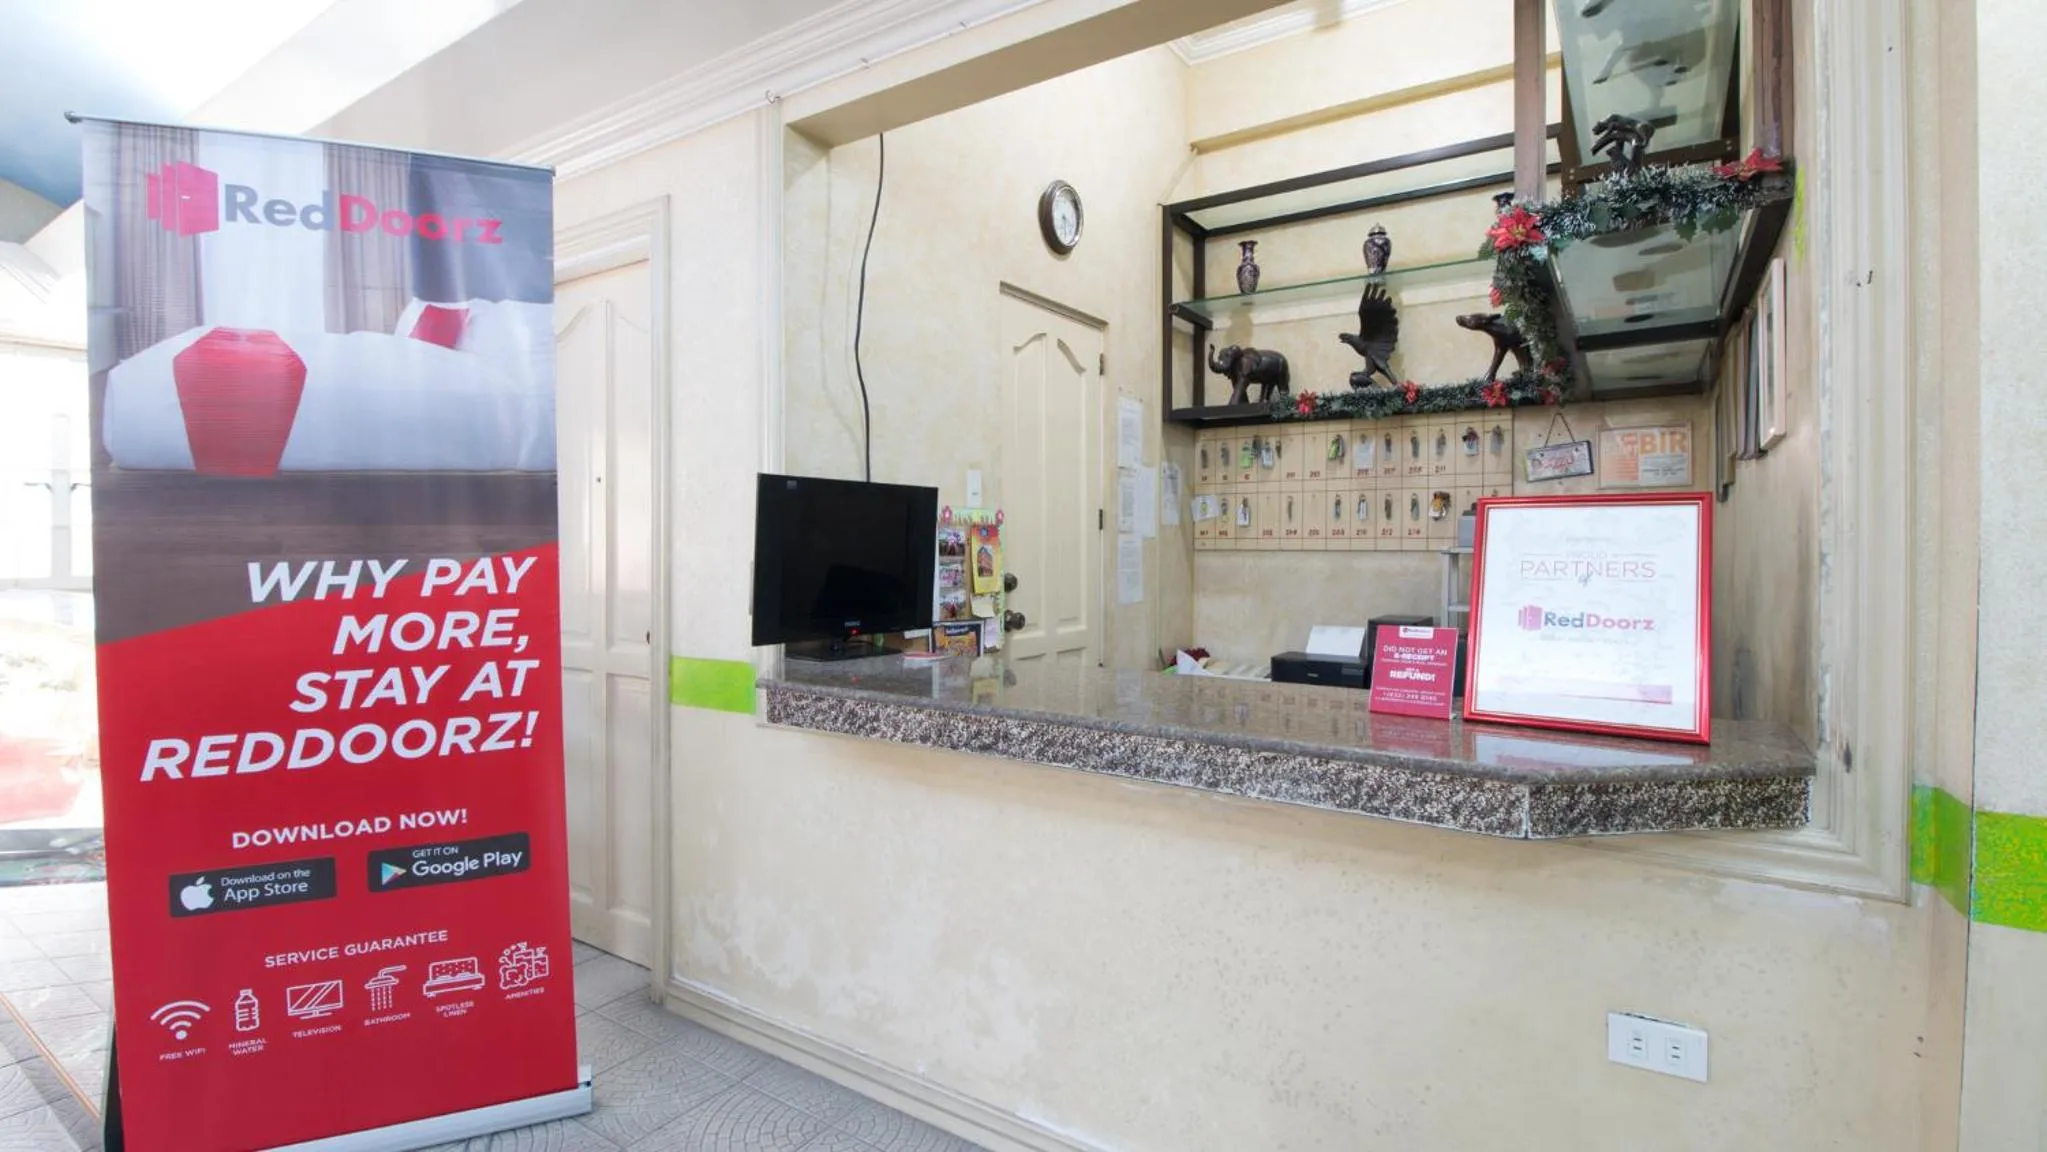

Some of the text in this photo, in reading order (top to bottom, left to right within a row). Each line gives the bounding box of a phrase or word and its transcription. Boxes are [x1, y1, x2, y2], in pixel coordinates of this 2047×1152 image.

[224, 183, 505, 246] RedDoorz
[1640, 431, 1687, 454] BIR
[1520, 560, 1657, 579] PARTNERS
[247, 556, 537, 603] WHY PAY
[1544, 611, 1656, 631] RedDoorz
[332, 608, 529, 655] MORE,
[290, 659, 540, 713] STAY AT
[140, 711, 540, 782] REDDOORZ!
[232, 808, 468, 849] DOWNLOAD NOW!
[412, 846, 459, 859] GET IT ON
[412, 851, 523, 877] Google Play
[221, 869, 311, 887] Download on the
[224, 881, 309, 903] App Store
[264, 930, 449, 969] SERVICE GUARANTEE
[505, 986, 545, 1000] AMENITIES
[436, 1001, 474, 1013] SPOTLESS
[443, 1009, 468, 1018] LINEN
[364, 1012, 411, 1026] BATHROOM
[292, 1025, 343, 1039] TELEVISION
[228, 1037, 268, 1049] MINERAL
[232, 1045, 265, 1056] WATER
[159, 1051, 183, 1061] FREE
